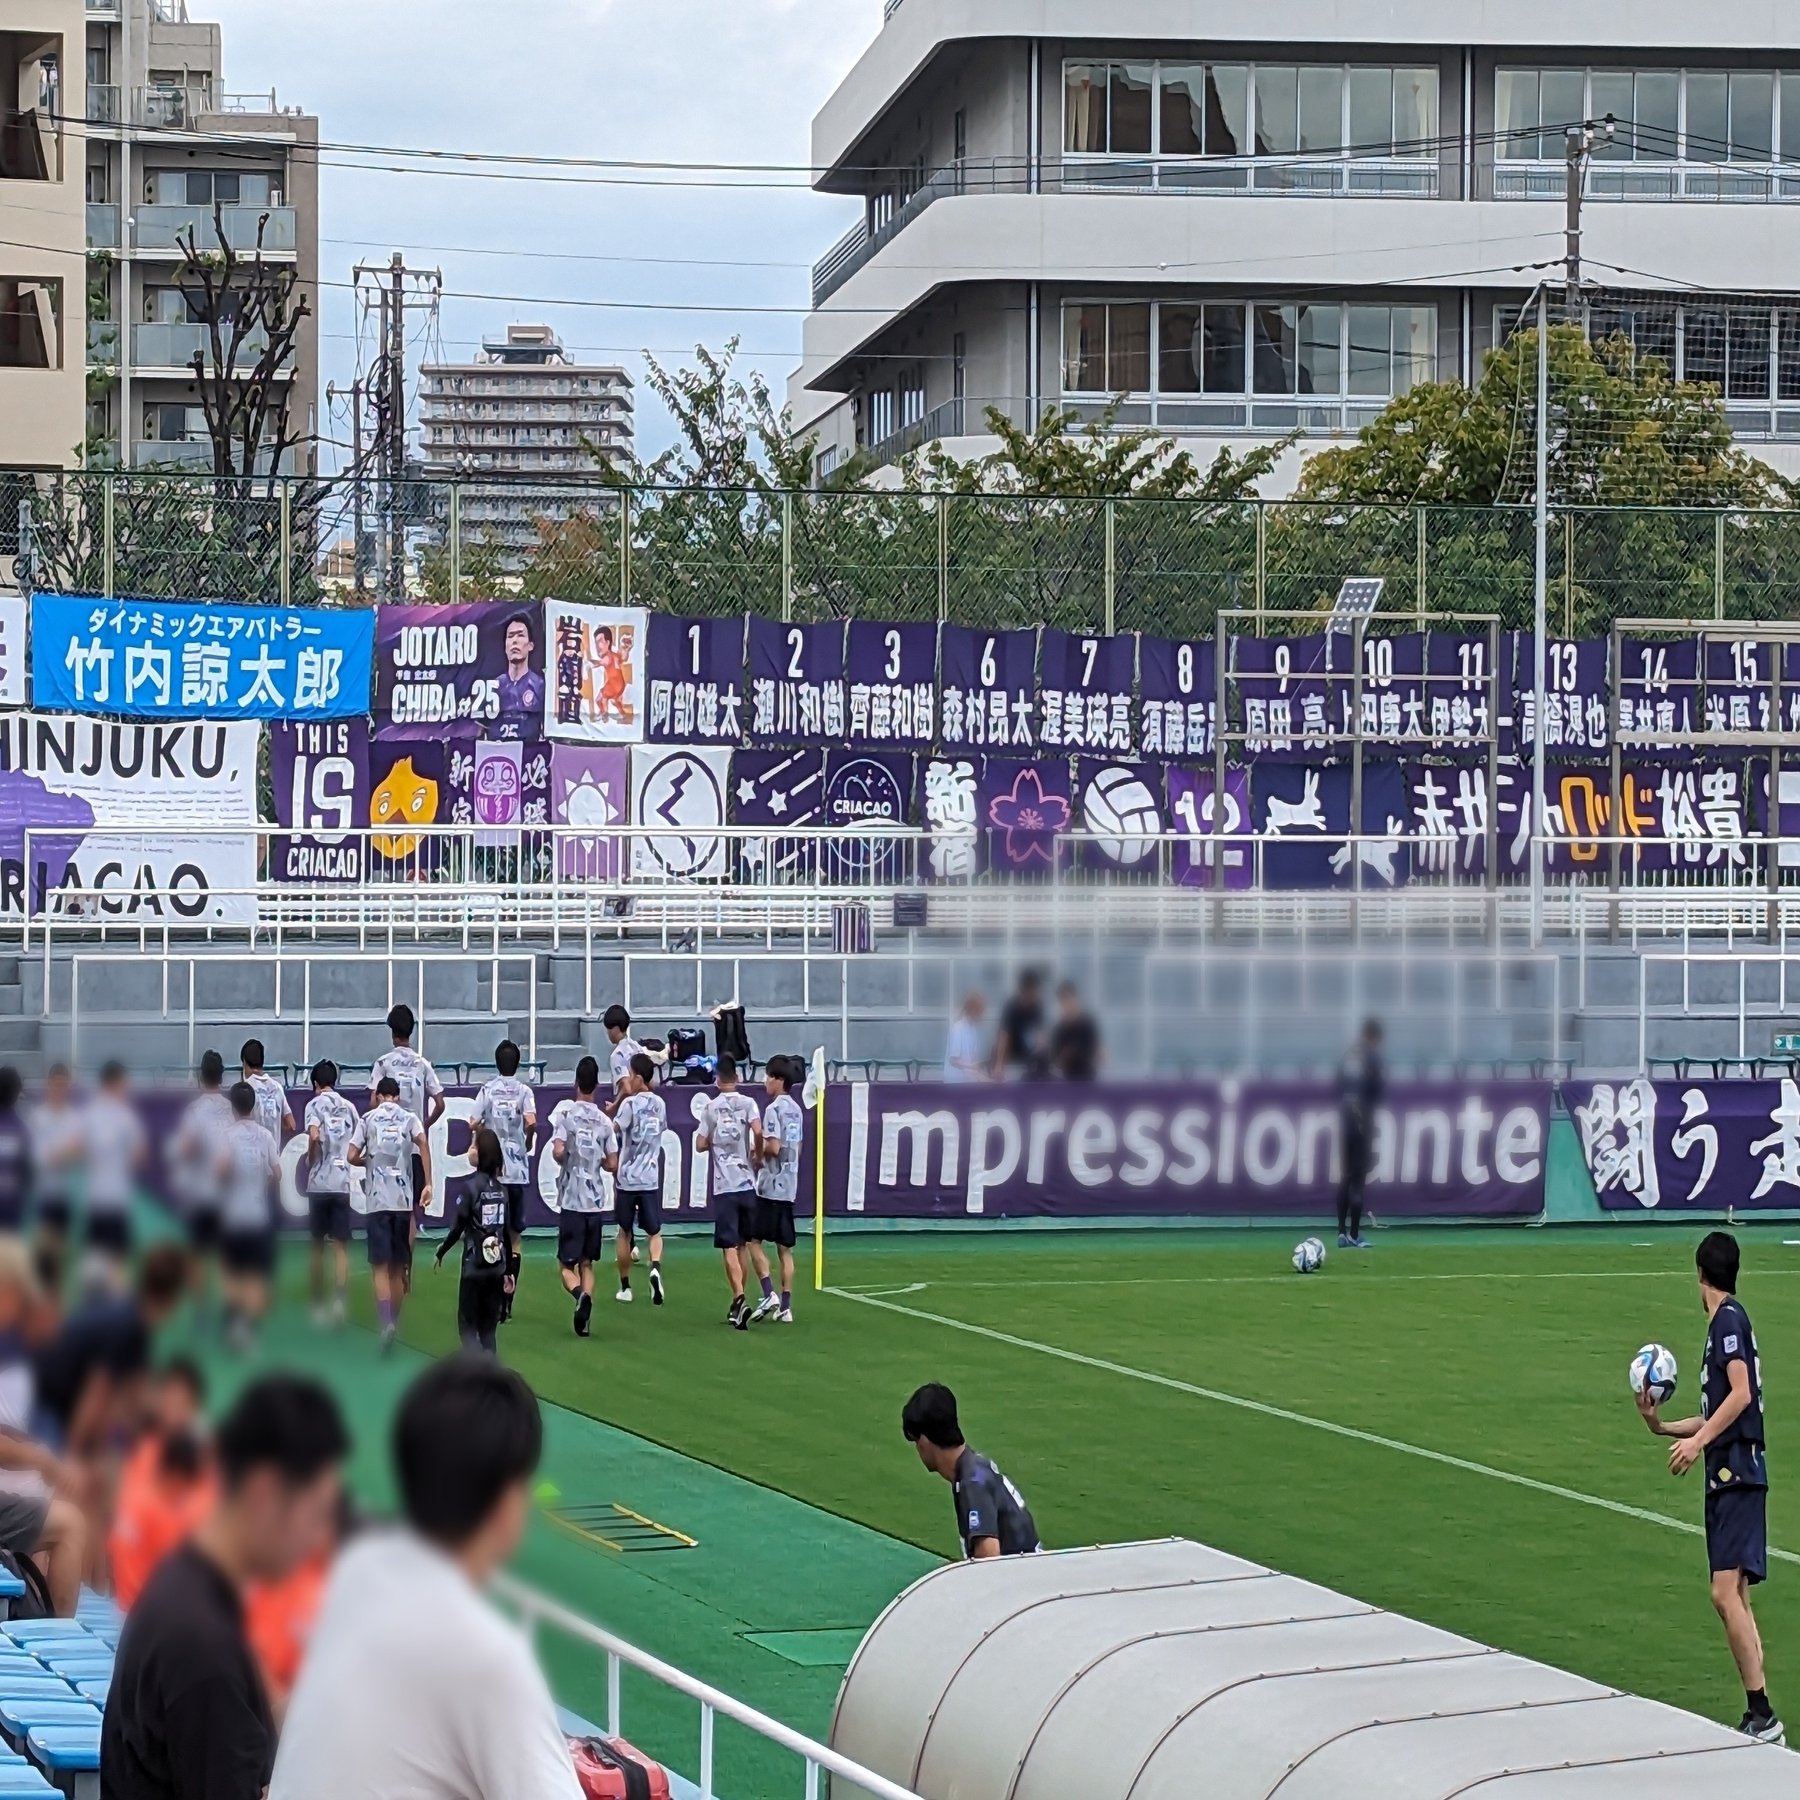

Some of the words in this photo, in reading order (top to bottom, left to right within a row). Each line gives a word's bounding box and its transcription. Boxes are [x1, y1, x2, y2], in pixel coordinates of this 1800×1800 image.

[88, 608, 322, 641] ダイナミックエアバトラー
[393, 624, 478, 666] JOTARO
[65, 636, 343, 709] 竹内諒太郎
[689, 625, 700, 675] 1
[787, 629, 804, 678] 2
[885, 630, 901, 679] 3
[981, 638, 996, 686] 6
[1082, 640, 1097, 686] 7
[1178, 645, 1193, 693] 8
[1275, 645, 1290, 693] 9
[1364, 640, 1393, 687] 10
[1458, 643, 1484, 690] 11
[1550, 644, 1577, 692] 13
[1641, 647, 1667, 693] 14
[1730, 642, 1757, 687] 15
[392, 683, 456, 723] CHIBA
[651, 680, 741, 738] 阿部雄太
[942, 685, 1033, 747] 森村昂太
[296, 722, 349, 755] THIS
[290, 755, 354, 843] IS
[833, 799, 892, 817] CRIACAO
[1174, 791, 1244, 867] 12
[287, 848, 357, 877] CRIACAO
